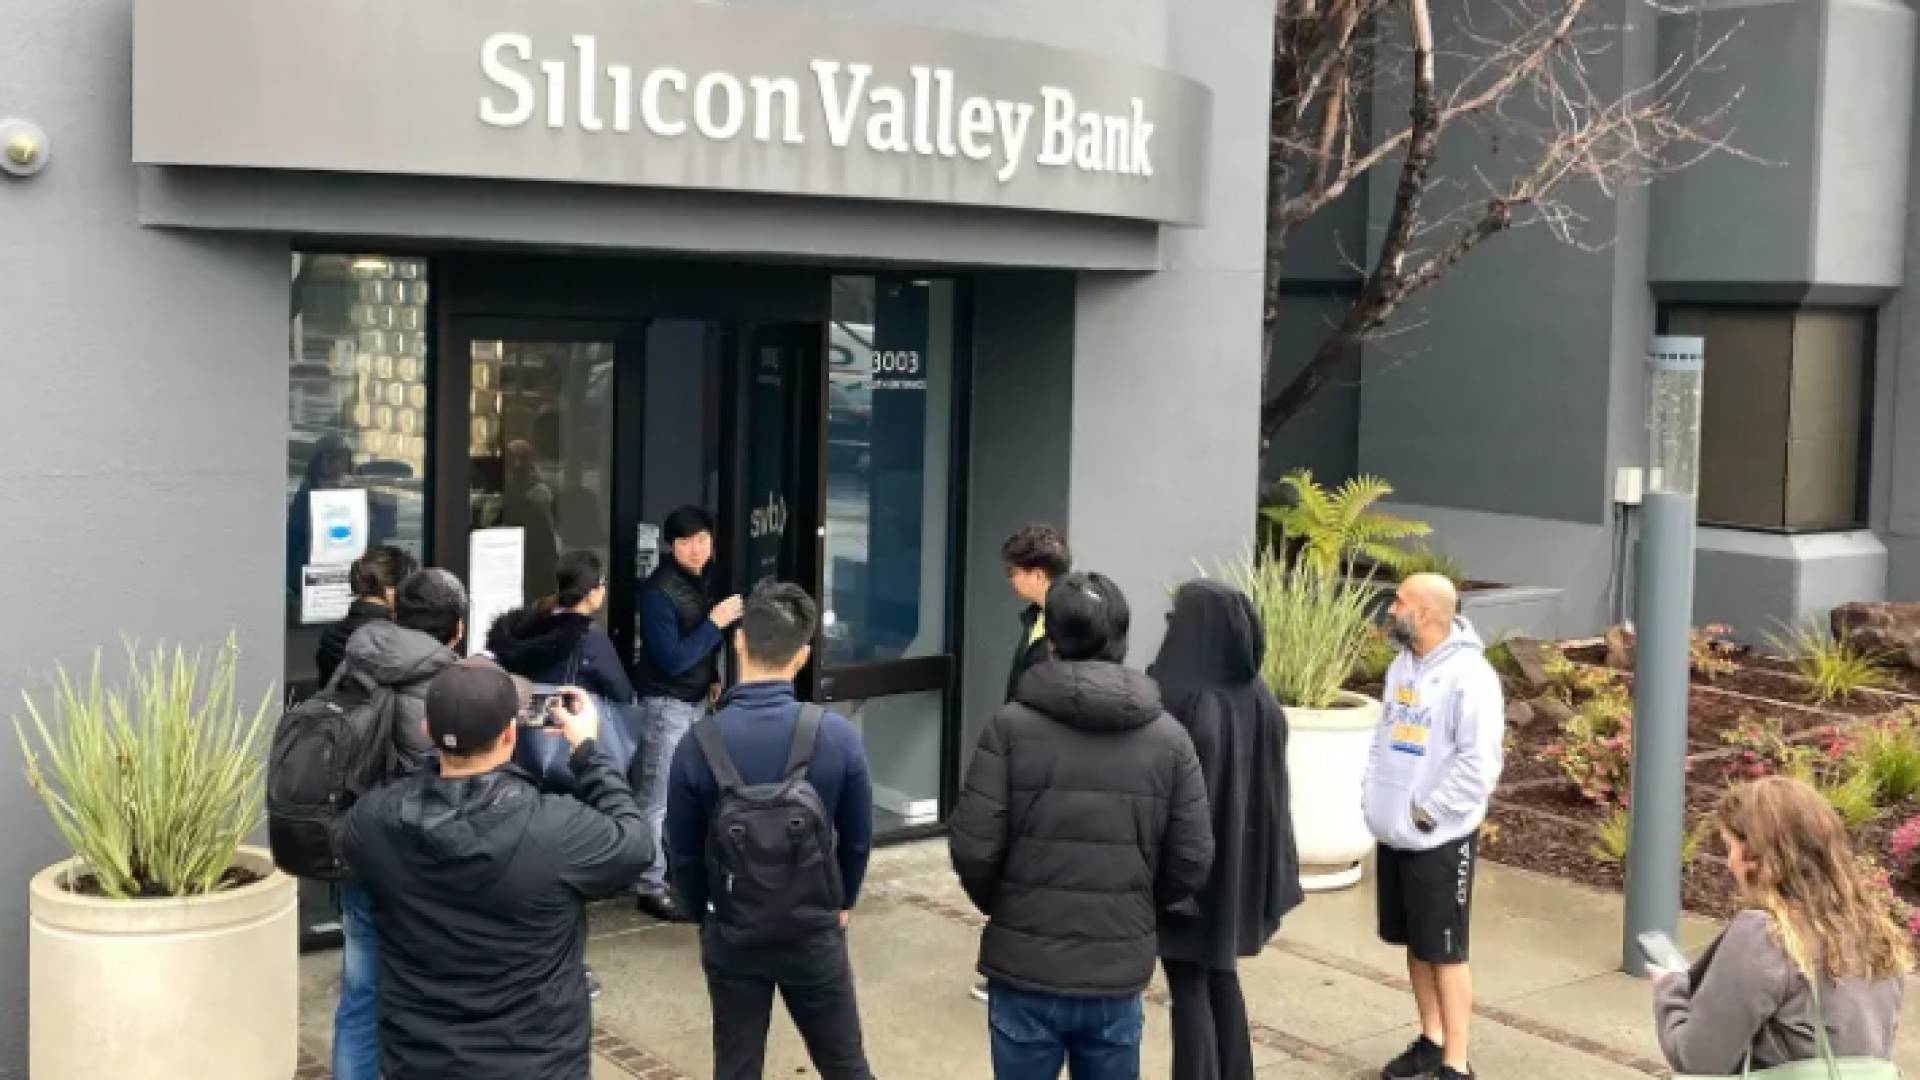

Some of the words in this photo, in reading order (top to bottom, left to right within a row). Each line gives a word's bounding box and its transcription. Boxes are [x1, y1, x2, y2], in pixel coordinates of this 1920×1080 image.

[479, 33, 804, 144] Silicon
[811, 58, 1034, 182] Valley
[1036, 85, 1156, 178] Bank
[871, 351, 919, 373] 3003
